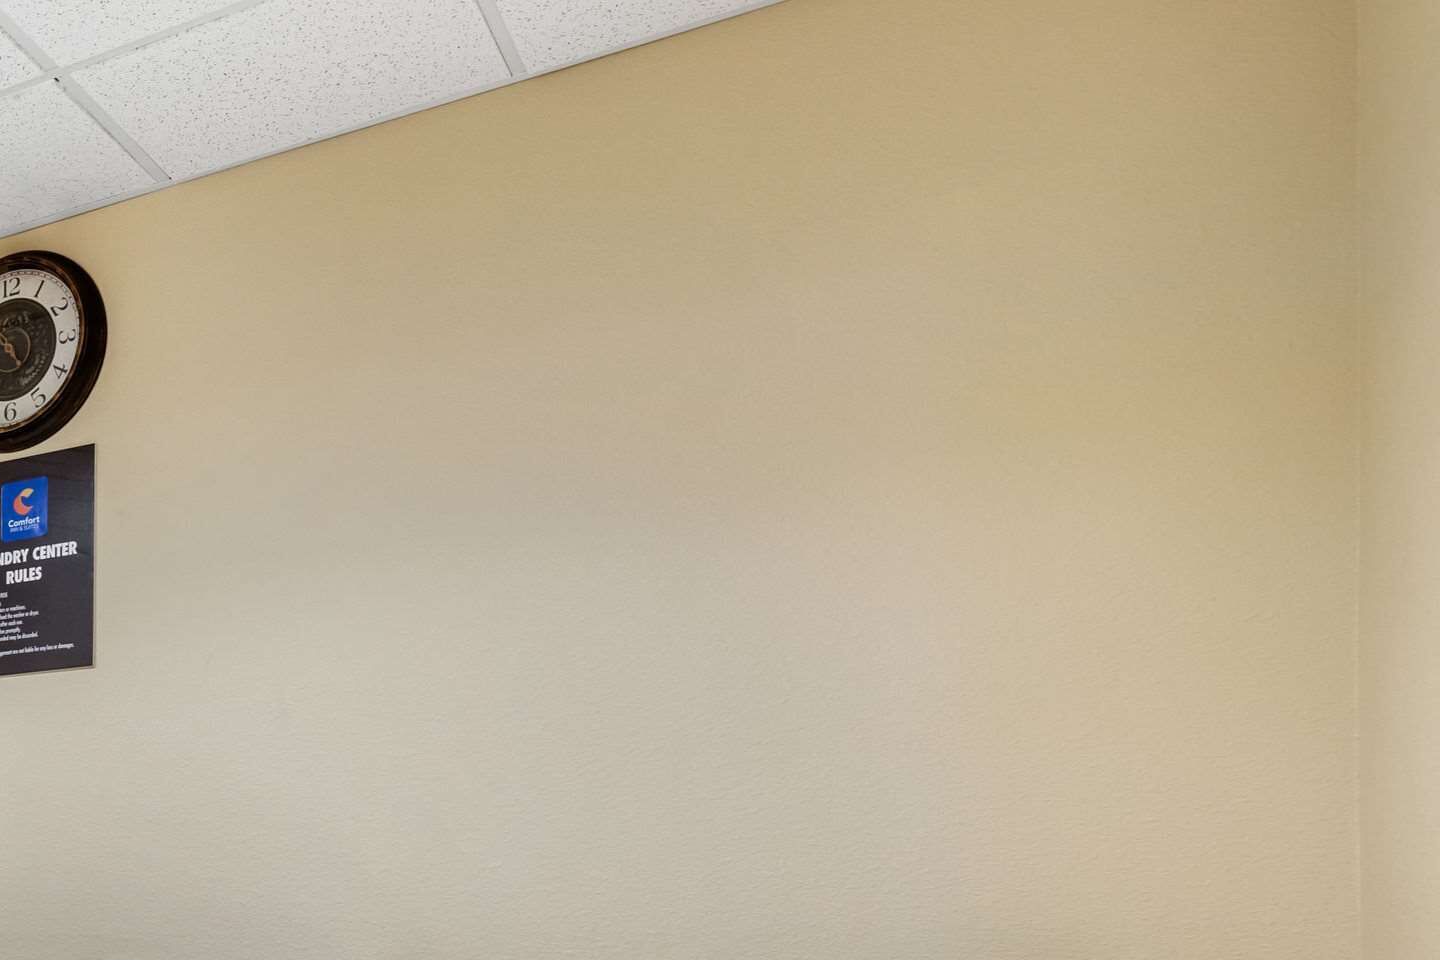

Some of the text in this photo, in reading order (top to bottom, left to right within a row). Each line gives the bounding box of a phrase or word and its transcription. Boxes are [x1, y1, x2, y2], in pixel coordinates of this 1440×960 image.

[2, 278, 20, 298] 12
[34, 280, 44, 298] 1
[50, 297, 68, 317] 2
[58, 328, 76, 344] 3
[53, 363, 68, 380] 4
[30, 388, 46, 408] 5
[4, 402, 16, 422] 6
[8, 516, 40, 528] Comfort
[32, 541, 78, 560] CENTER
[6, 566, 42, 584] RULES
